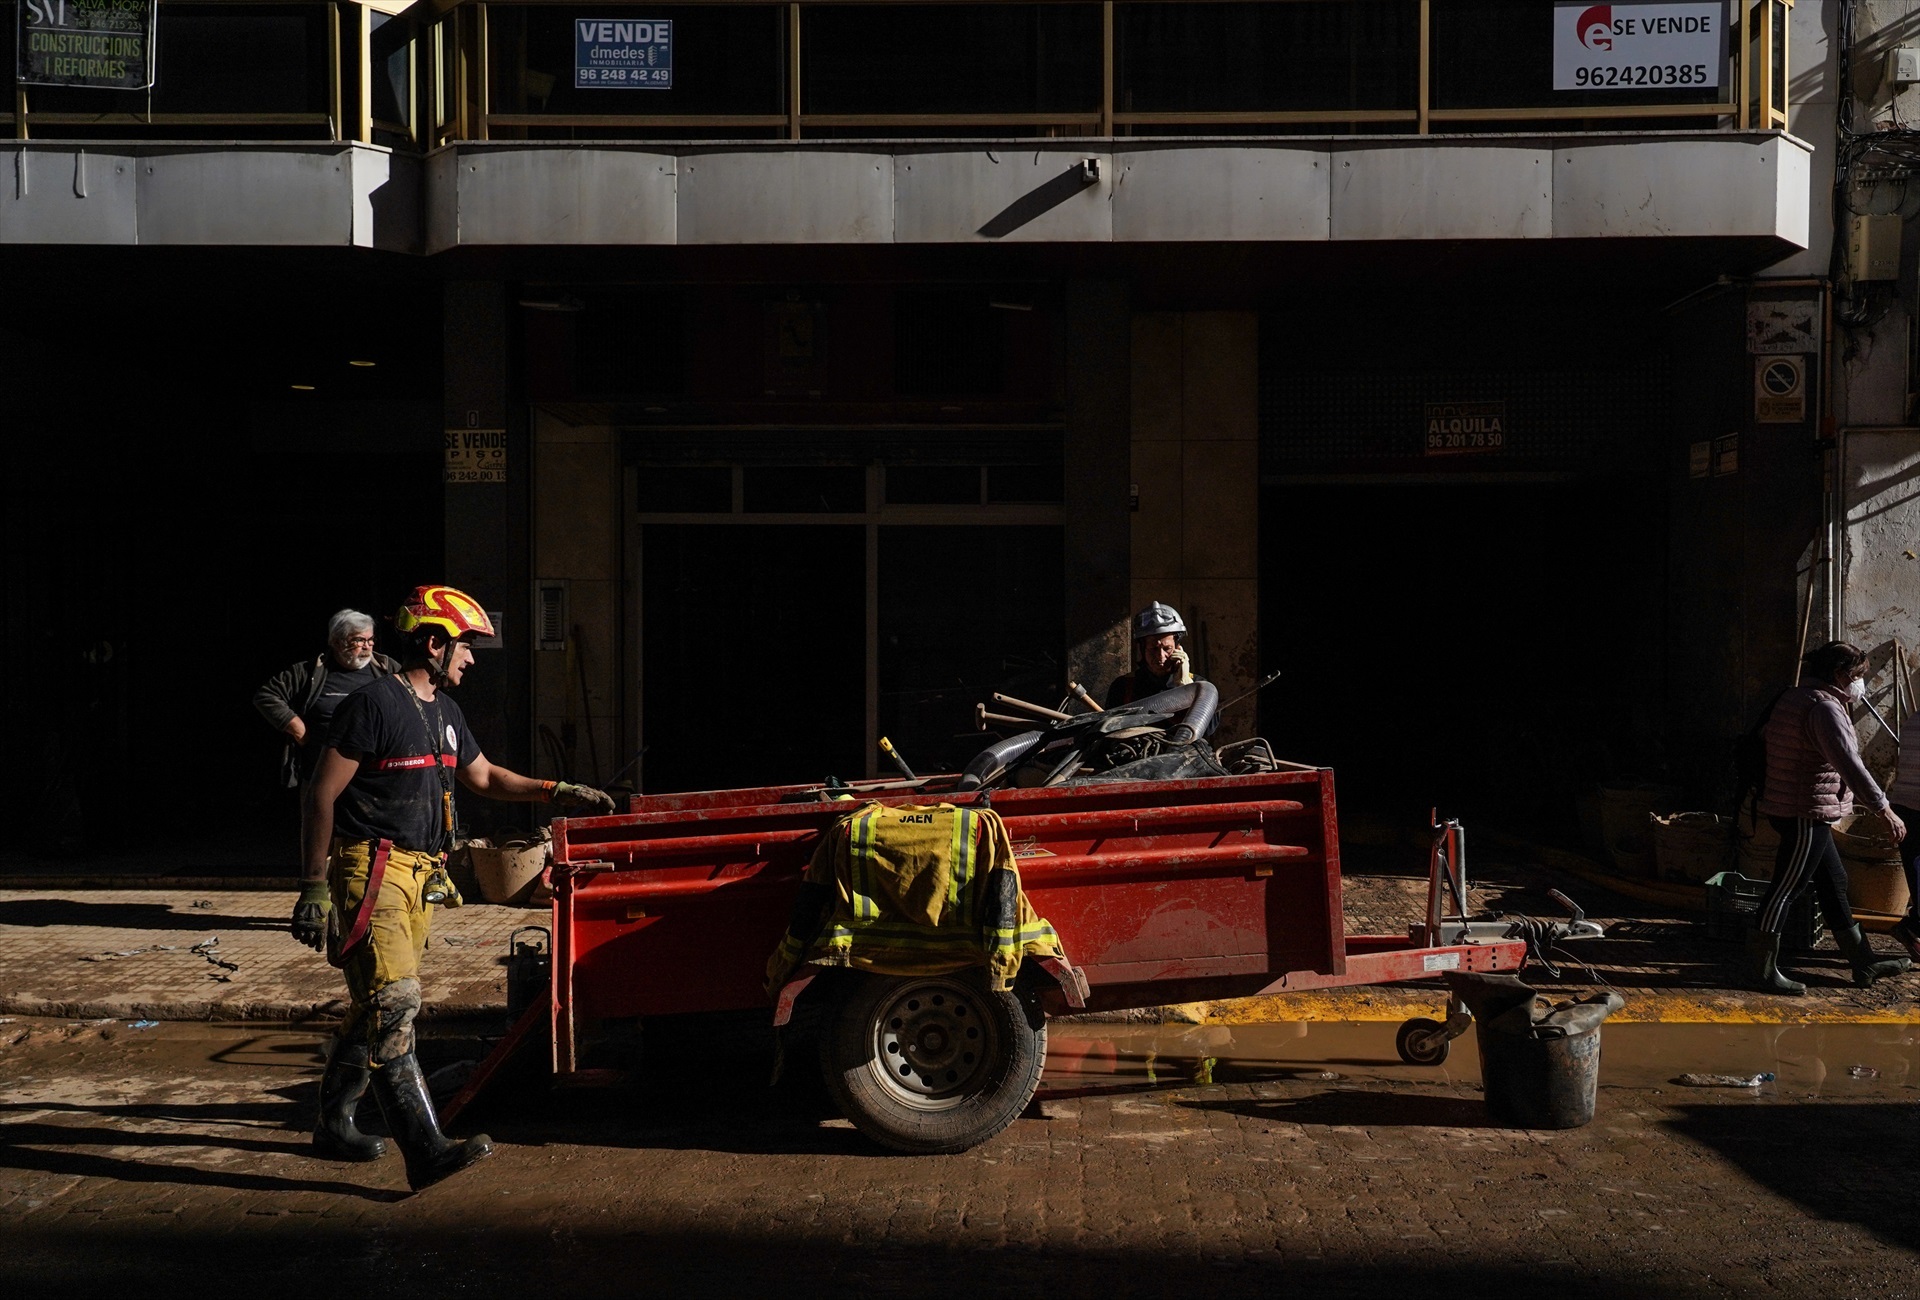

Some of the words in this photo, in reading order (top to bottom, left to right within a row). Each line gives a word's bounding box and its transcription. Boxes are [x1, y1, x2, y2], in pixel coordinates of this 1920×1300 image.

[71, 0, 106, 10] SALVA
[111, 0, 148, 12] MORA
[579, 22, 669, 43] VENDE
[1613, 19, 1636, 35] SE
[1641, 16, 1711, 34] VENDE
[31, 32, 141, 57] CONSTRUCCIONS
[590, 44, 645, 59] dmedes
[45, 56, 49, 75] I
[54, 57, 126, 79] REFORMES
[580, 69, 597, 80] 96
[601, 69, 626, 80] 248
[630, 70, 648, 80] 42
[651, 70, 669, 81] 49
[1575, 64, 1707, 87] 962420385
[1428, 417, 1502, 433] ALQUILA
[443, 432, 459, 449] SE
[463, 432, 508, 449] VENDE
[1428, 434, 1443, 447] 96
[1445, 434, 1466, 447] 201
[1469, 433, 1485, 447] 78
[1487, 432, 1502, 446] 50
[450, 449, 503, 459] PISO
[458, 471, 478, 480] 242
[480, 471, 493, 480] 00
[387, 759, 425, 768] BOMBEROS
[899, 814, 933, 824] JAEN
